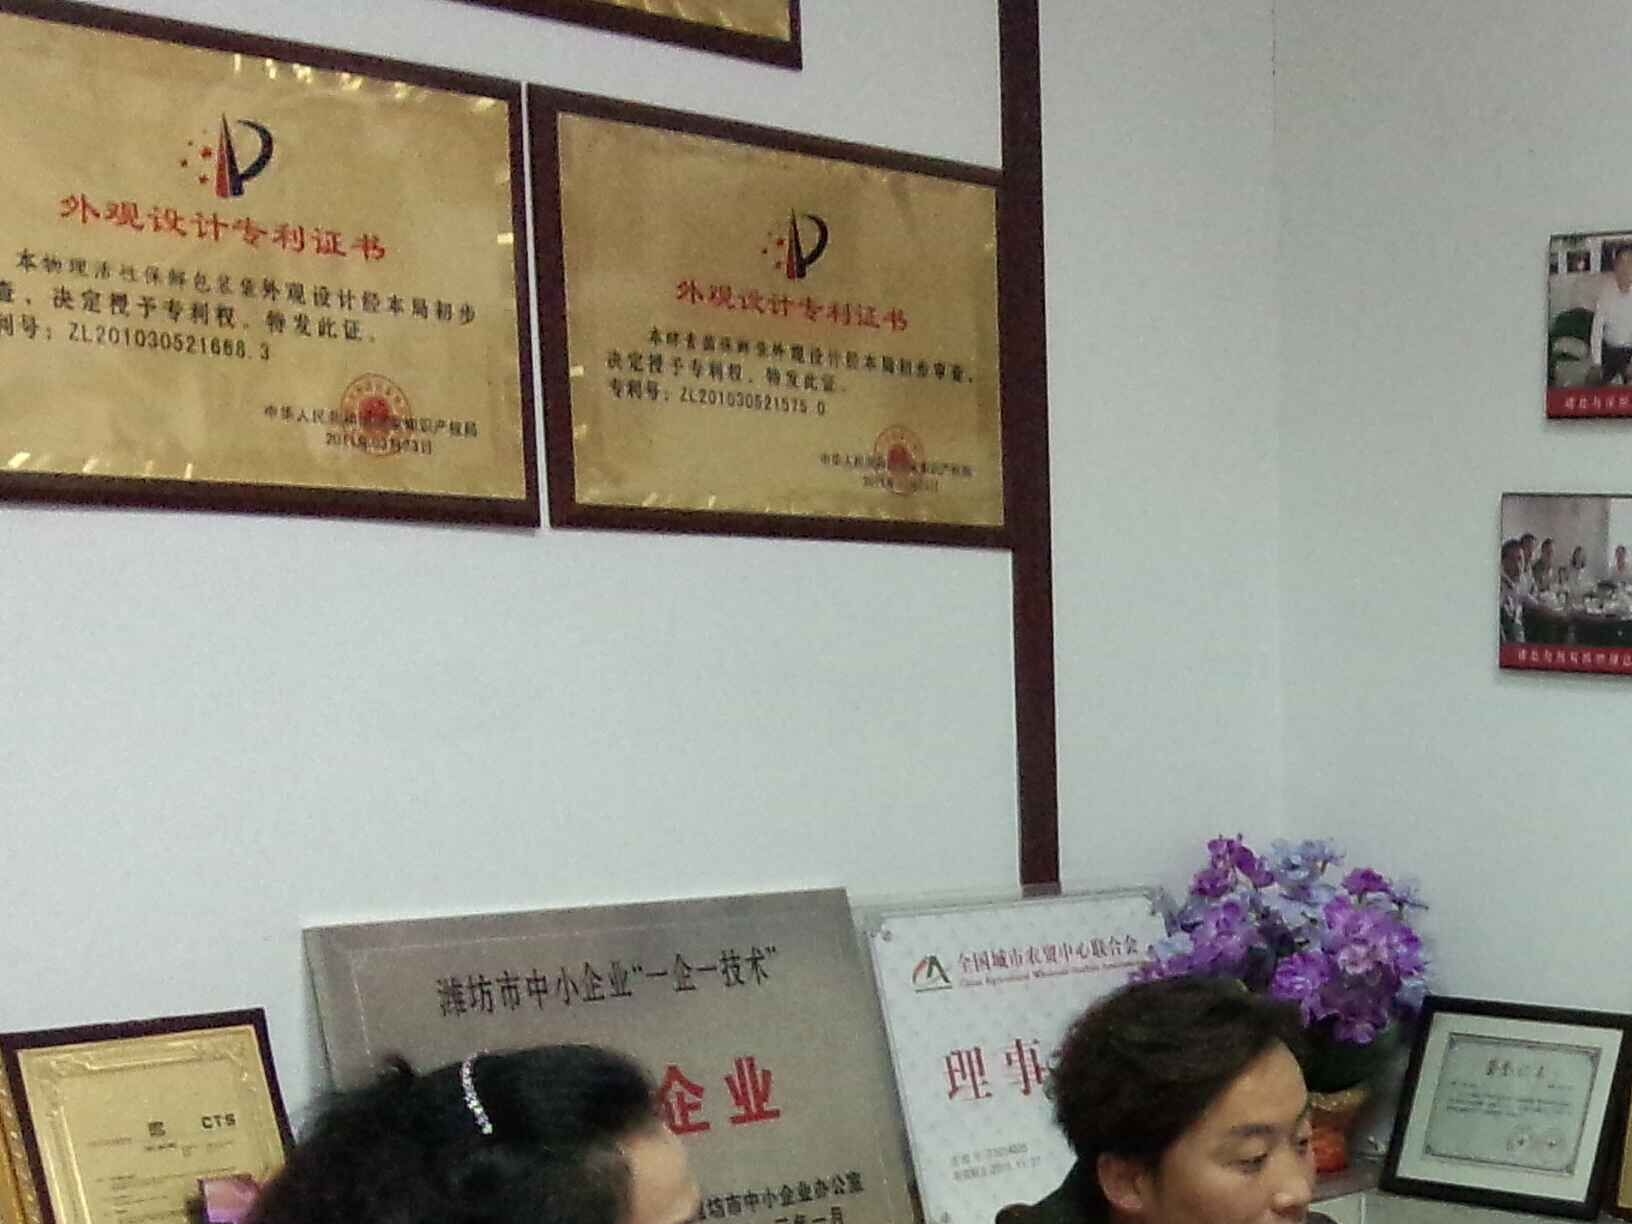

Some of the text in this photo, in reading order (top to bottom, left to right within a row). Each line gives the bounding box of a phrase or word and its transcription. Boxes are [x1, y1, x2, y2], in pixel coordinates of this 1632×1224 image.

[60, 193, 387, 261] 外观设计专利证书
[675, 279, 909, 332] 外观设计专利证书
[659, 1056, 782, 1136] 企业
[945, 1036, 1052, 1102] 理事
[201, 1112, 237, 1131] CTS
[699, 1171, 865, 1220] 坊市中小企业办公室
